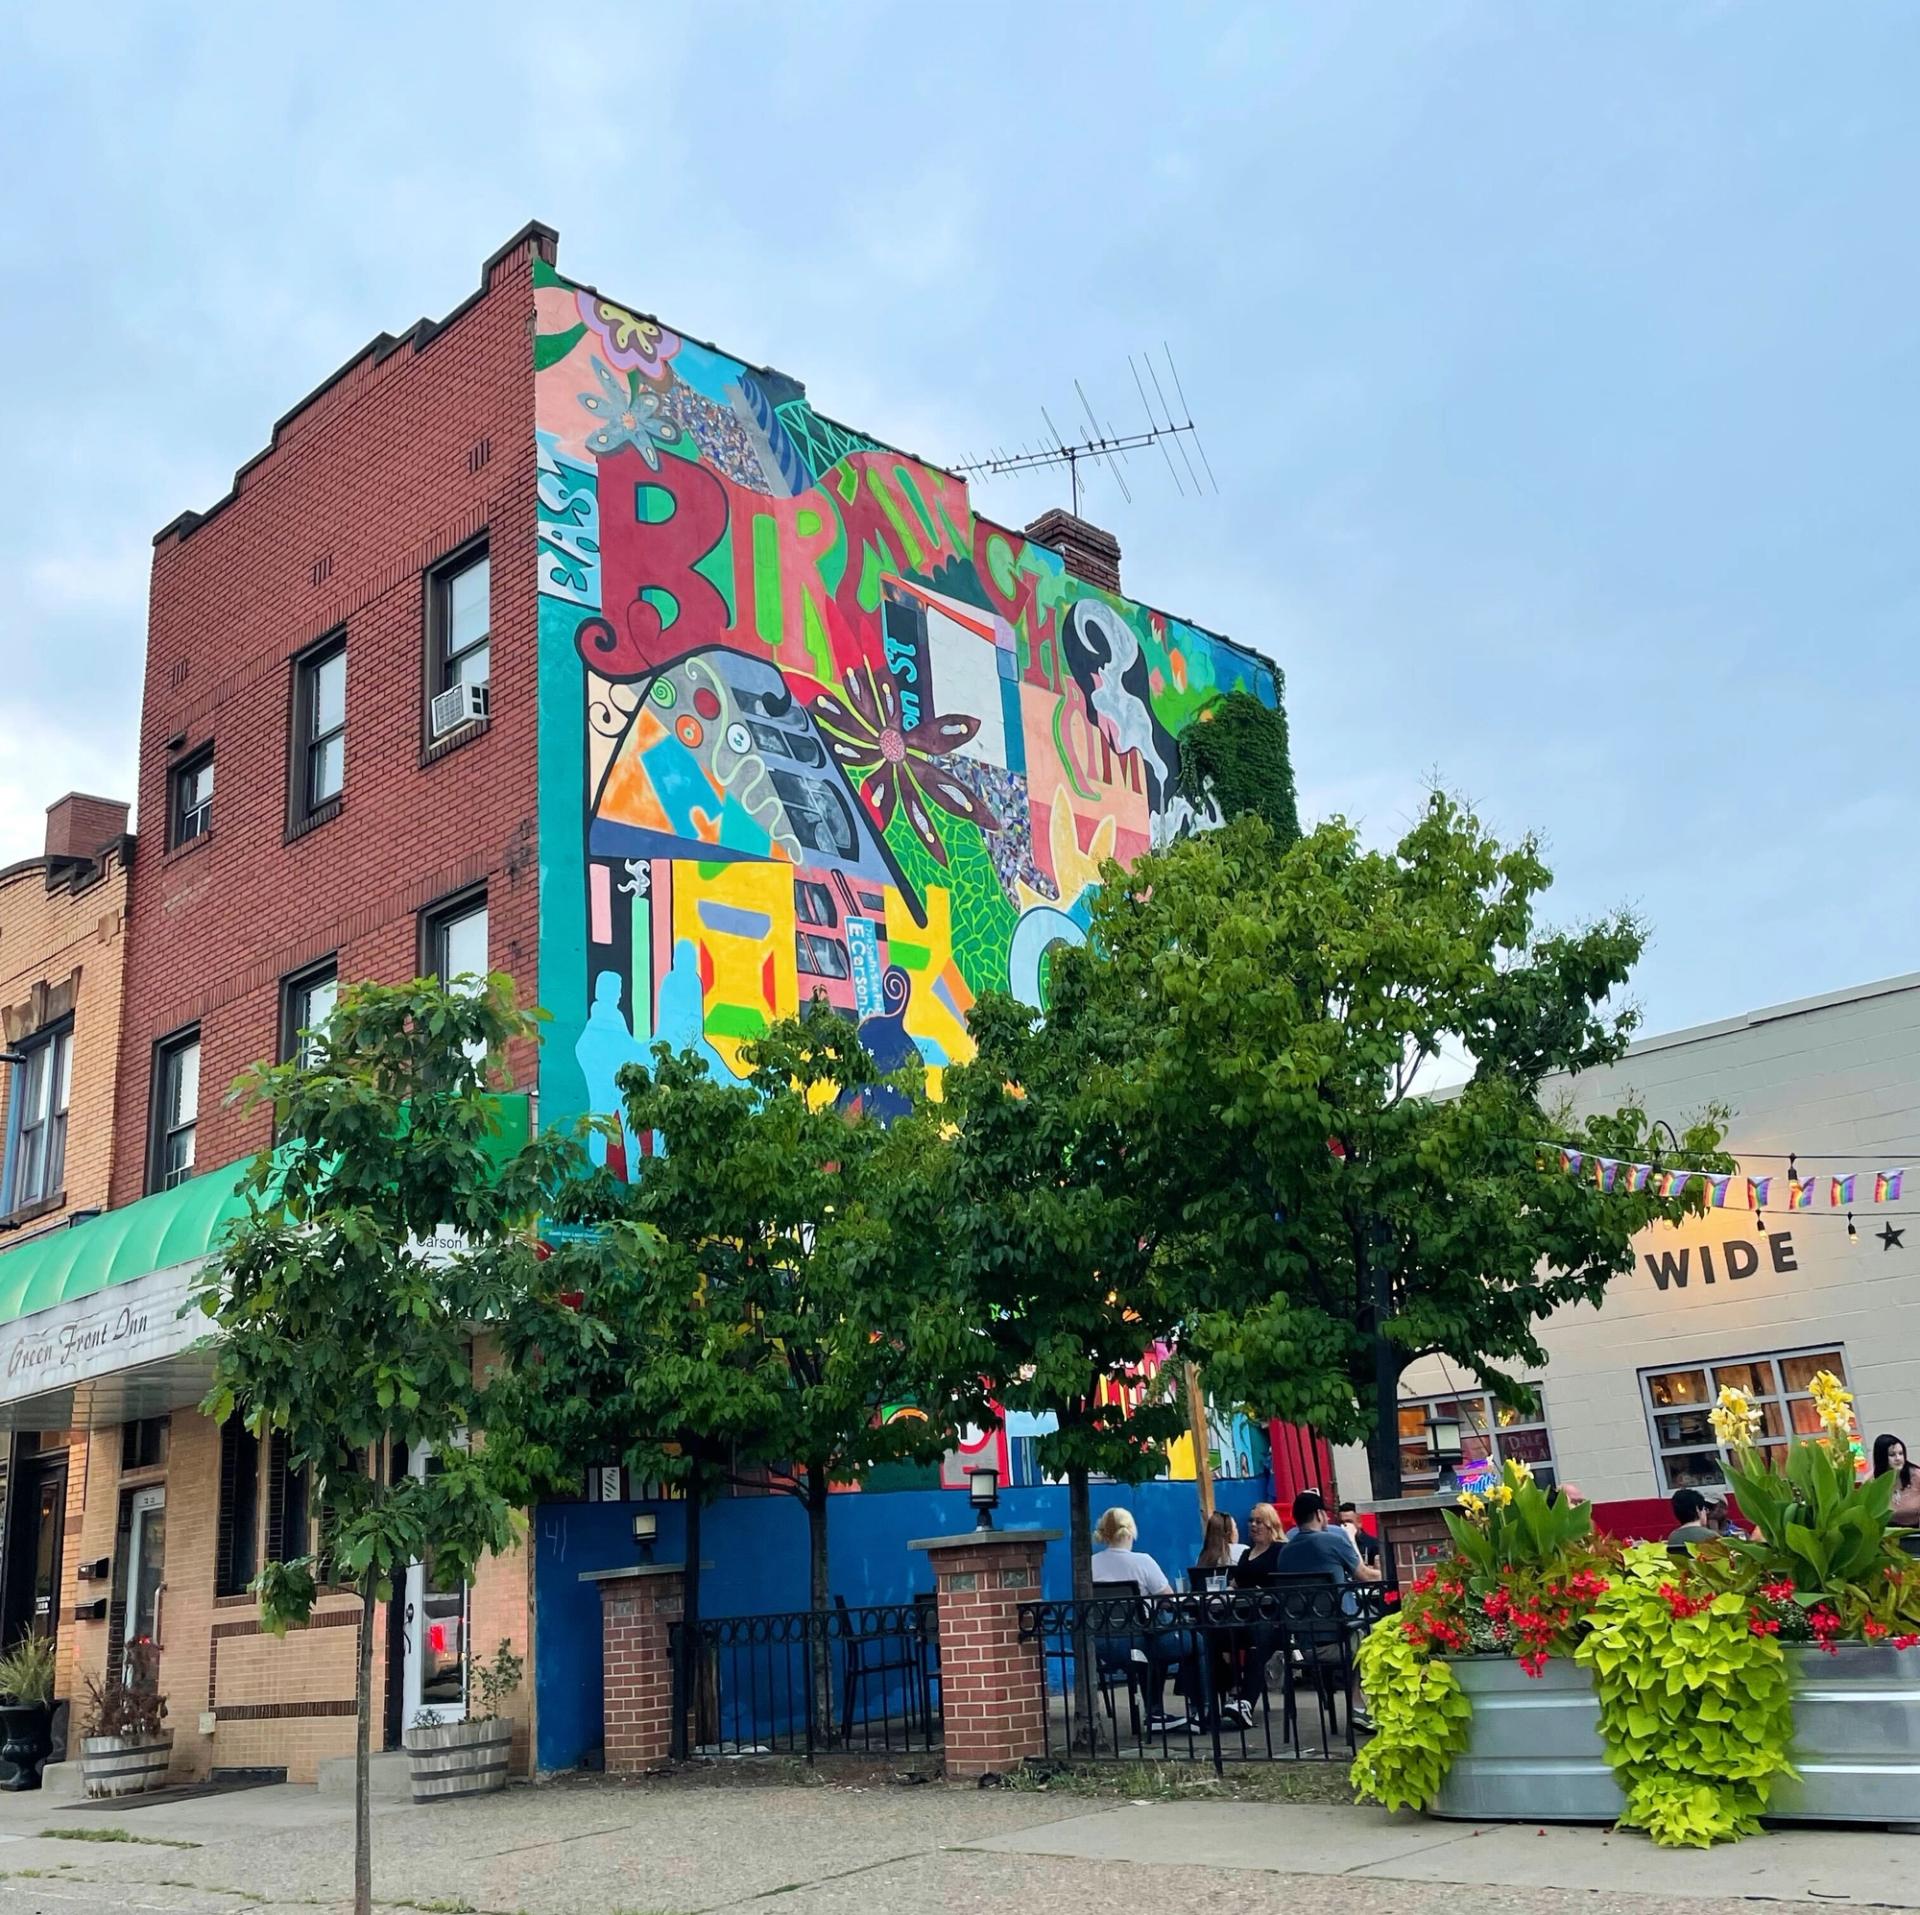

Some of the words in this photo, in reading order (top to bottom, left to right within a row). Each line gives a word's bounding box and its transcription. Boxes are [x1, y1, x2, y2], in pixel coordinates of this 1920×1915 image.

[887, 636, 918, 684] St
[848, 922, 865, 937] E
[851, 940, 869, 1006] Carson
[1644, 1231, 1798, 1291] WIDE
[7, 1337, 53, 1378] Green
[58, 1324, 108, 1365] Front
[112, 1306, 148, 1341] Inn
